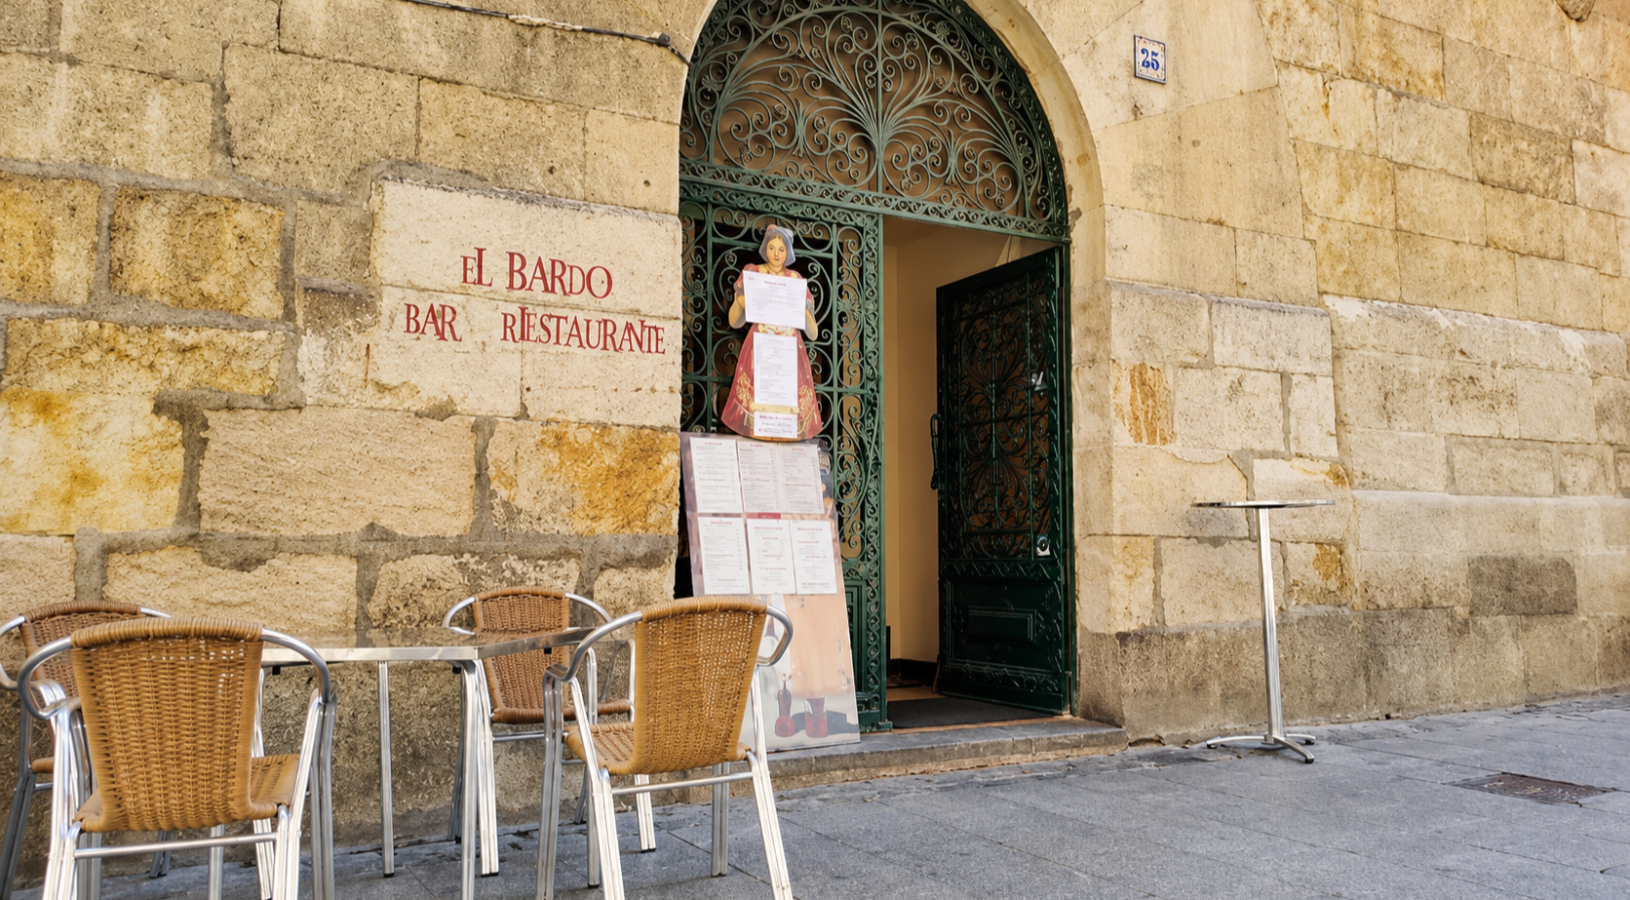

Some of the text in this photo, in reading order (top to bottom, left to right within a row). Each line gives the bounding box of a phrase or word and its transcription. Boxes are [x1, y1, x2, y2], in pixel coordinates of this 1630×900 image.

[1140, 47, 1160, 72] 25
[460, 247, 613, 299] EL BARDO
[403, 303, 462, 342] BAR
